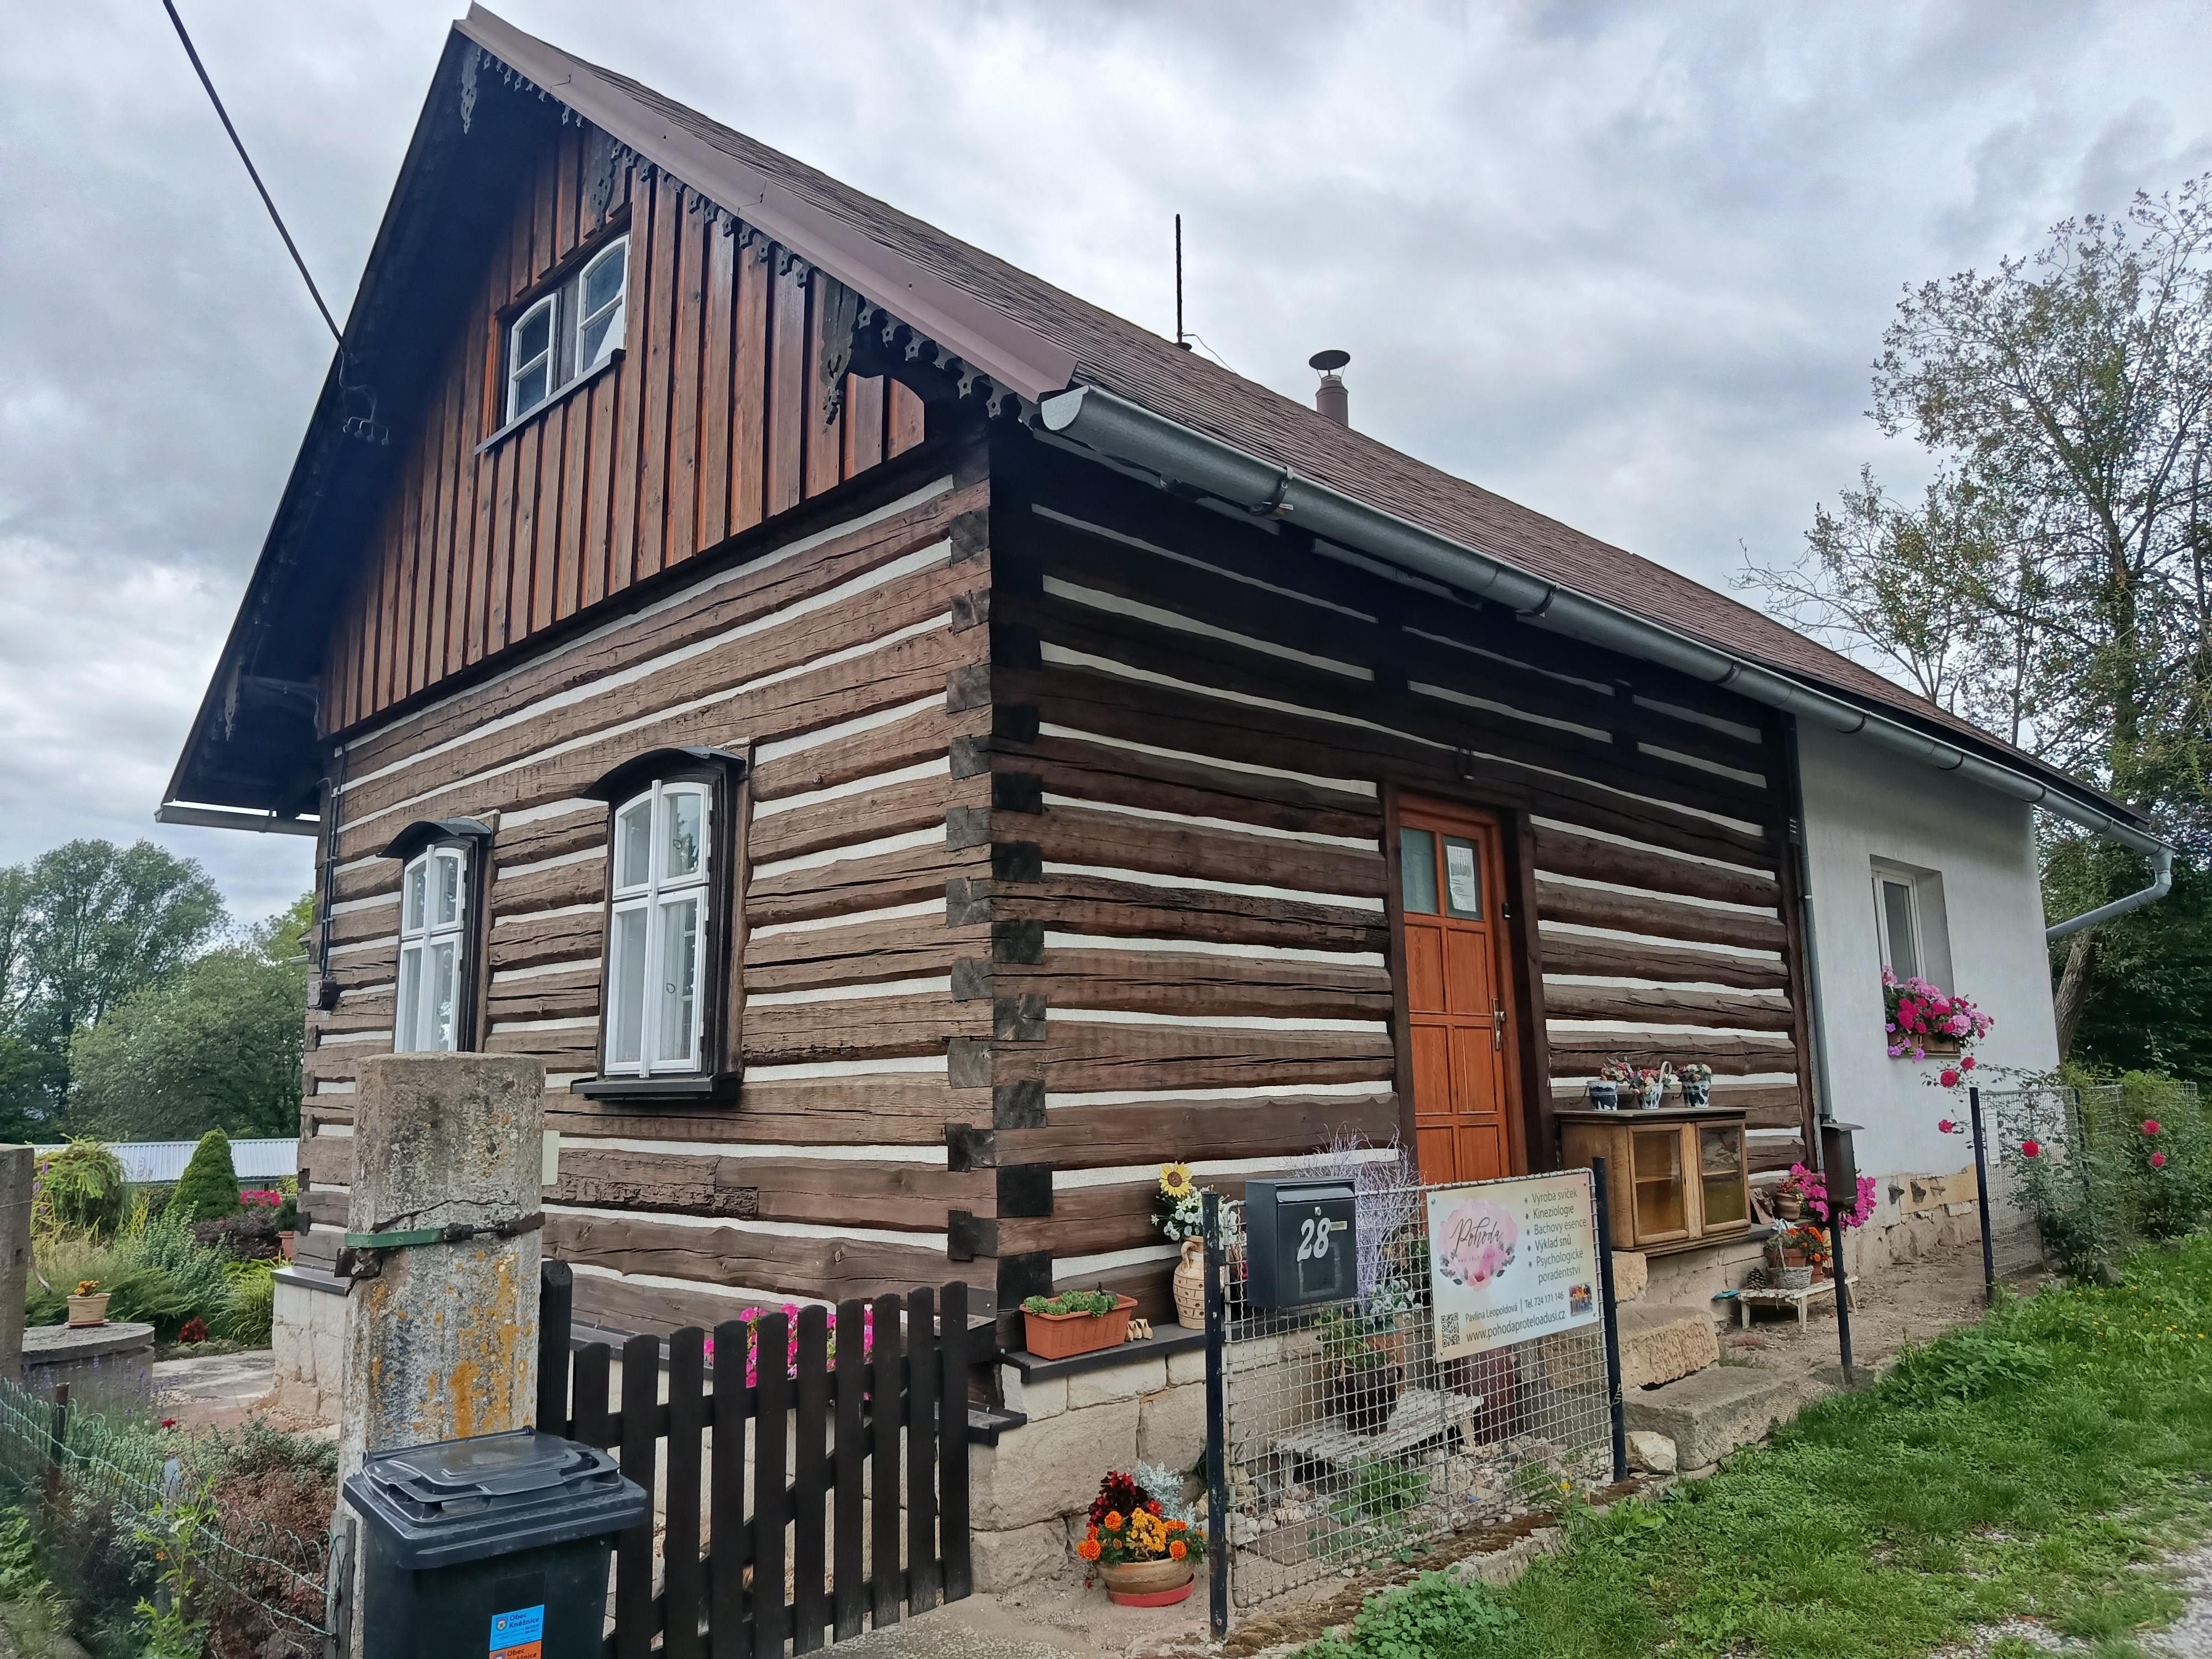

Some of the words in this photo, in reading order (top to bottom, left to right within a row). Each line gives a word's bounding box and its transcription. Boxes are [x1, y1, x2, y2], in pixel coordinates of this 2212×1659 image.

[1531, 1191, 1556, 1206] Výroba
[1558, 1187, 1578, 1199] svíček
[1533, 1204, 1574, 1219] Kineziologie
[1449, 1217, 1504, 1254] Pohoda
[1535, 1222, 1562, 1235] Bachovy
[1564, 1218, 1587, 1230] esence
[1297, 1217, 1331, 1262] 28
[1535, 1236, 1558, 1253] Výklad
[1559, 1234, 1571, 1246] snů
[1536, 1248, 1583, 1269] Psychologické
[1486, 1302, 1517, 1318] Leopoldová
[1534, 1297, 1543, 1306] 724
[1545, 1294, 1553, 1303] 171
[1554, 1291, 1564, 1300] 146
[1466, 1310, 1566, 1343] www.pohodaproteloadusi.cz
[509, 1618, 540, 1628] Kněžnice
[507, 1648, 525, 1657] Obec
